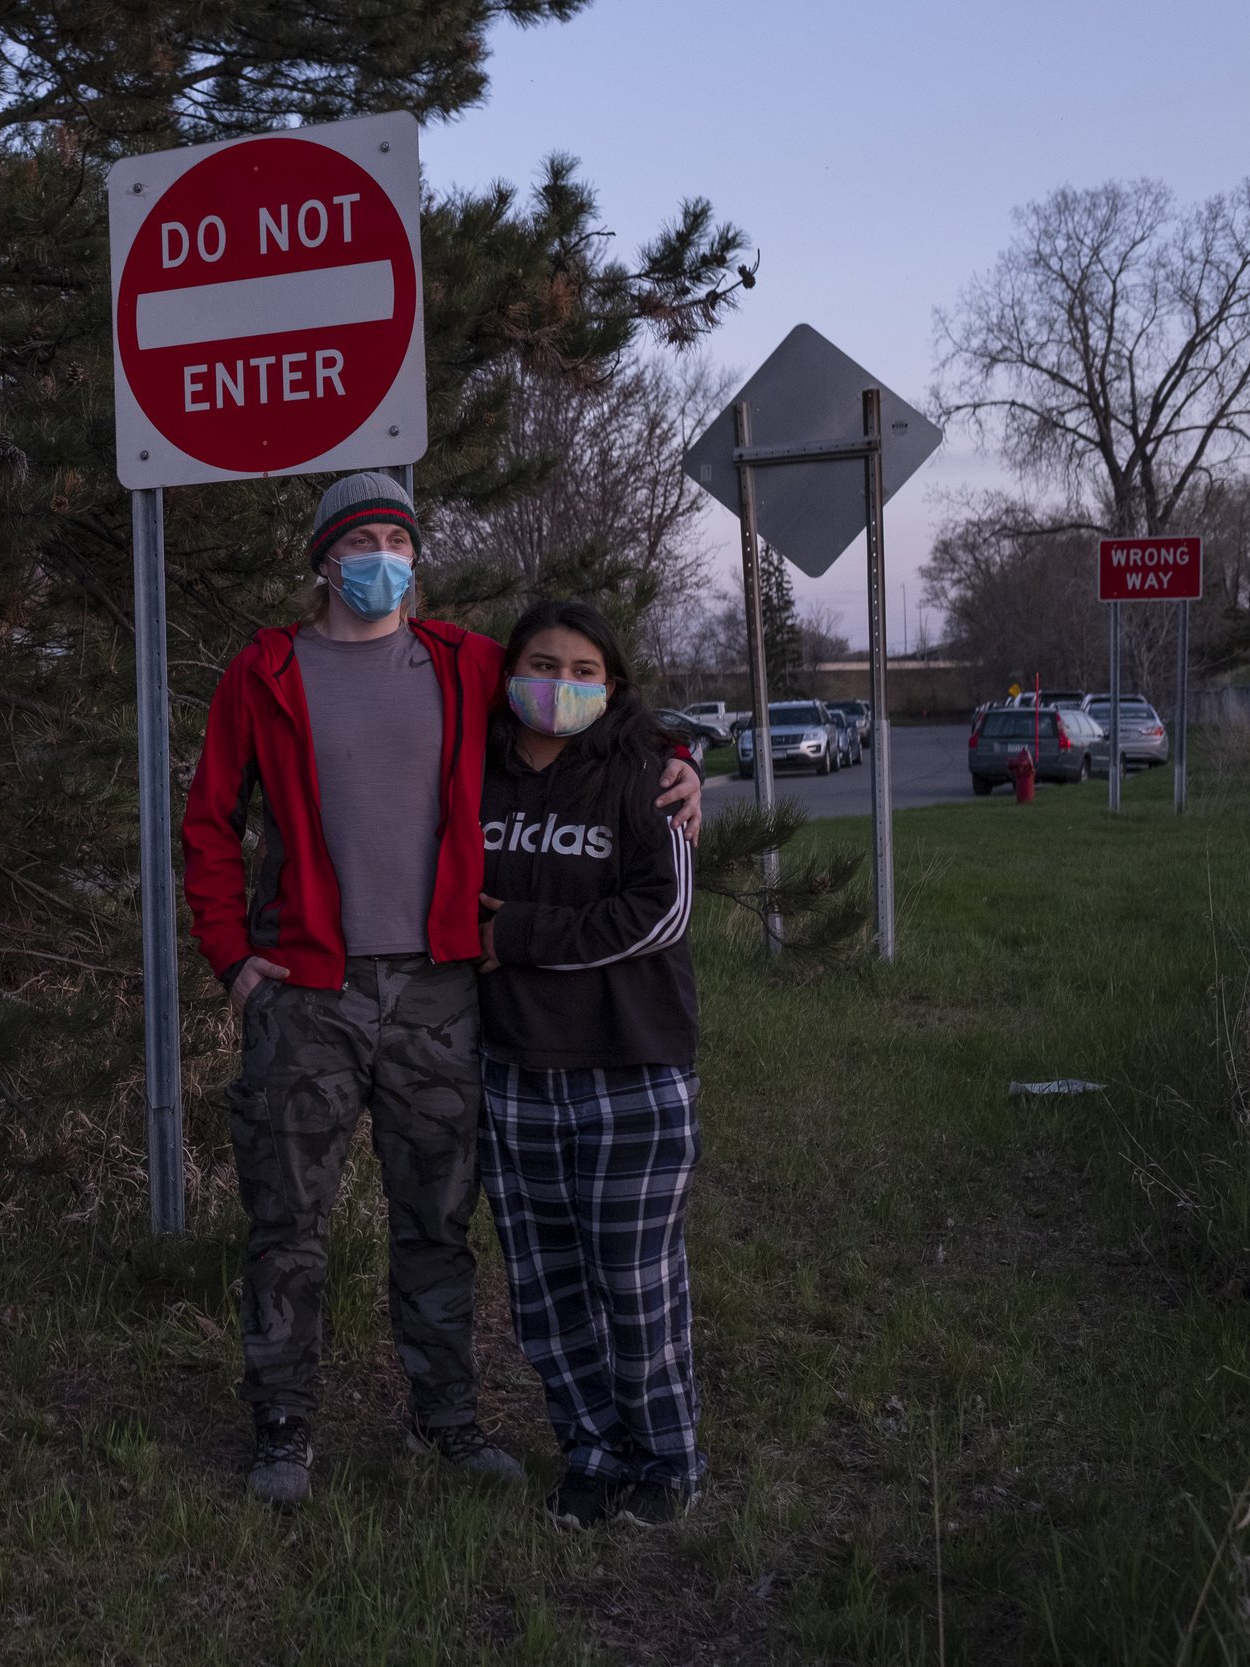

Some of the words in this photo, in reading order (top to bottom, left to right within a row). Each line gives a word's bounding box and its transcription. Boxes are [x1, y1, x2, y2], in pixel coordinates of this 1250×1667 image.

[161, 214, 227, 269] DO
[258, 192, 361, 255] NOT
[183, 348, 346, 412] ENTER
[1111, 547, 1190, 567] WRONG
[1126, 571, 1173, 591] WAY
[479, 812, 613, 859] didas
